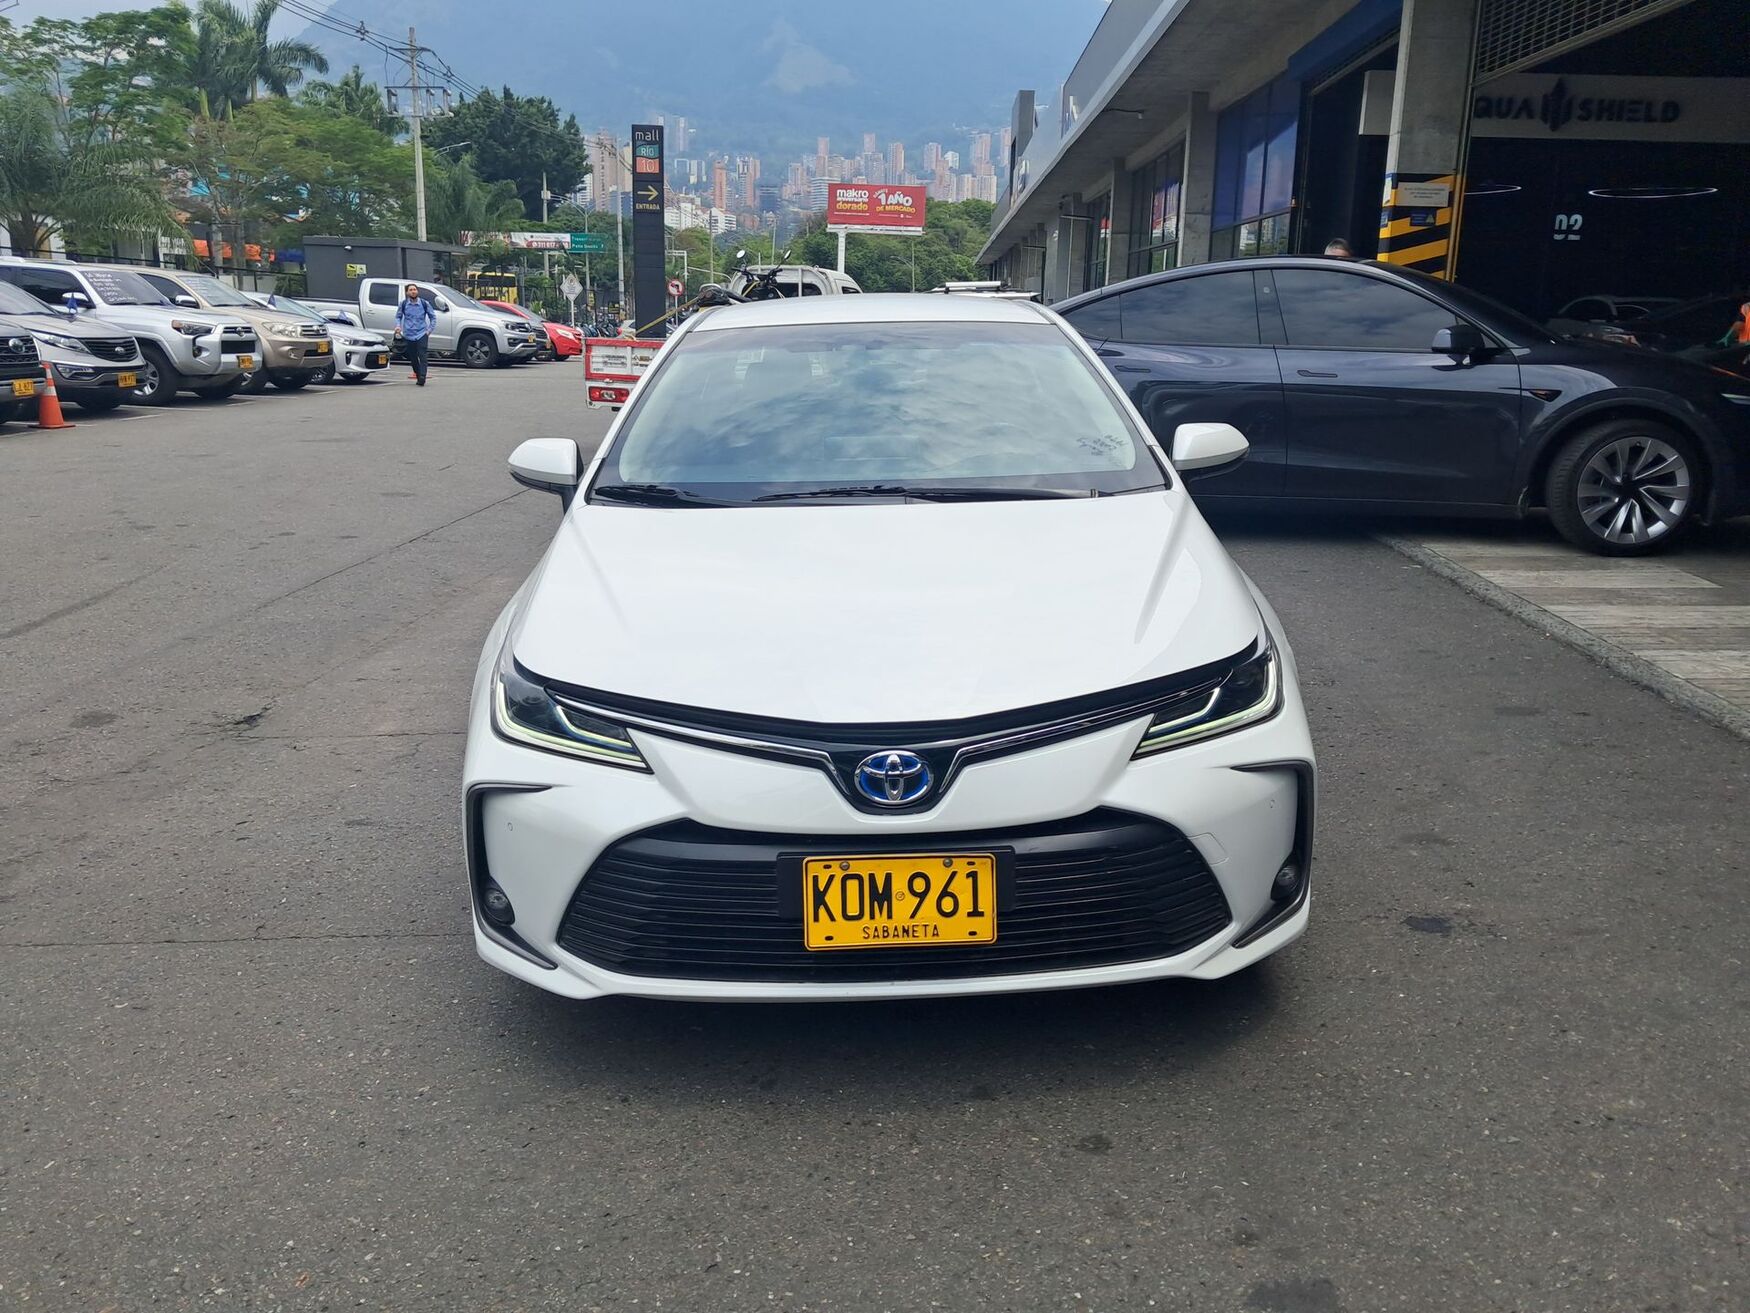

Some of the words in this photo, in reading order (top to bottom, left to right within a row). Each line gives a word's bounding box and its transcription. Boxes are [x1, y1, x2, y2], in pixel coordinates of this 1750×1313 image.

[1577, 99, 1681, 123] SHIELD
[636, 129, 659, 141] mall
[641, 159, 655, 172] 10
[837, 189, 868, 198] makro
[878, 192, 886, 205] 1
[888, 192, 913, 206] AÑO
[837, 202, 868, 210] dorado
[885, 205, 916, 213] MERCADO
[1553, 214, 1583, 240] 02
[812, 872, 894, 923] KOM
[907, 871, 985, 919] 961
[862, 924, 940, 940] SABANETA
